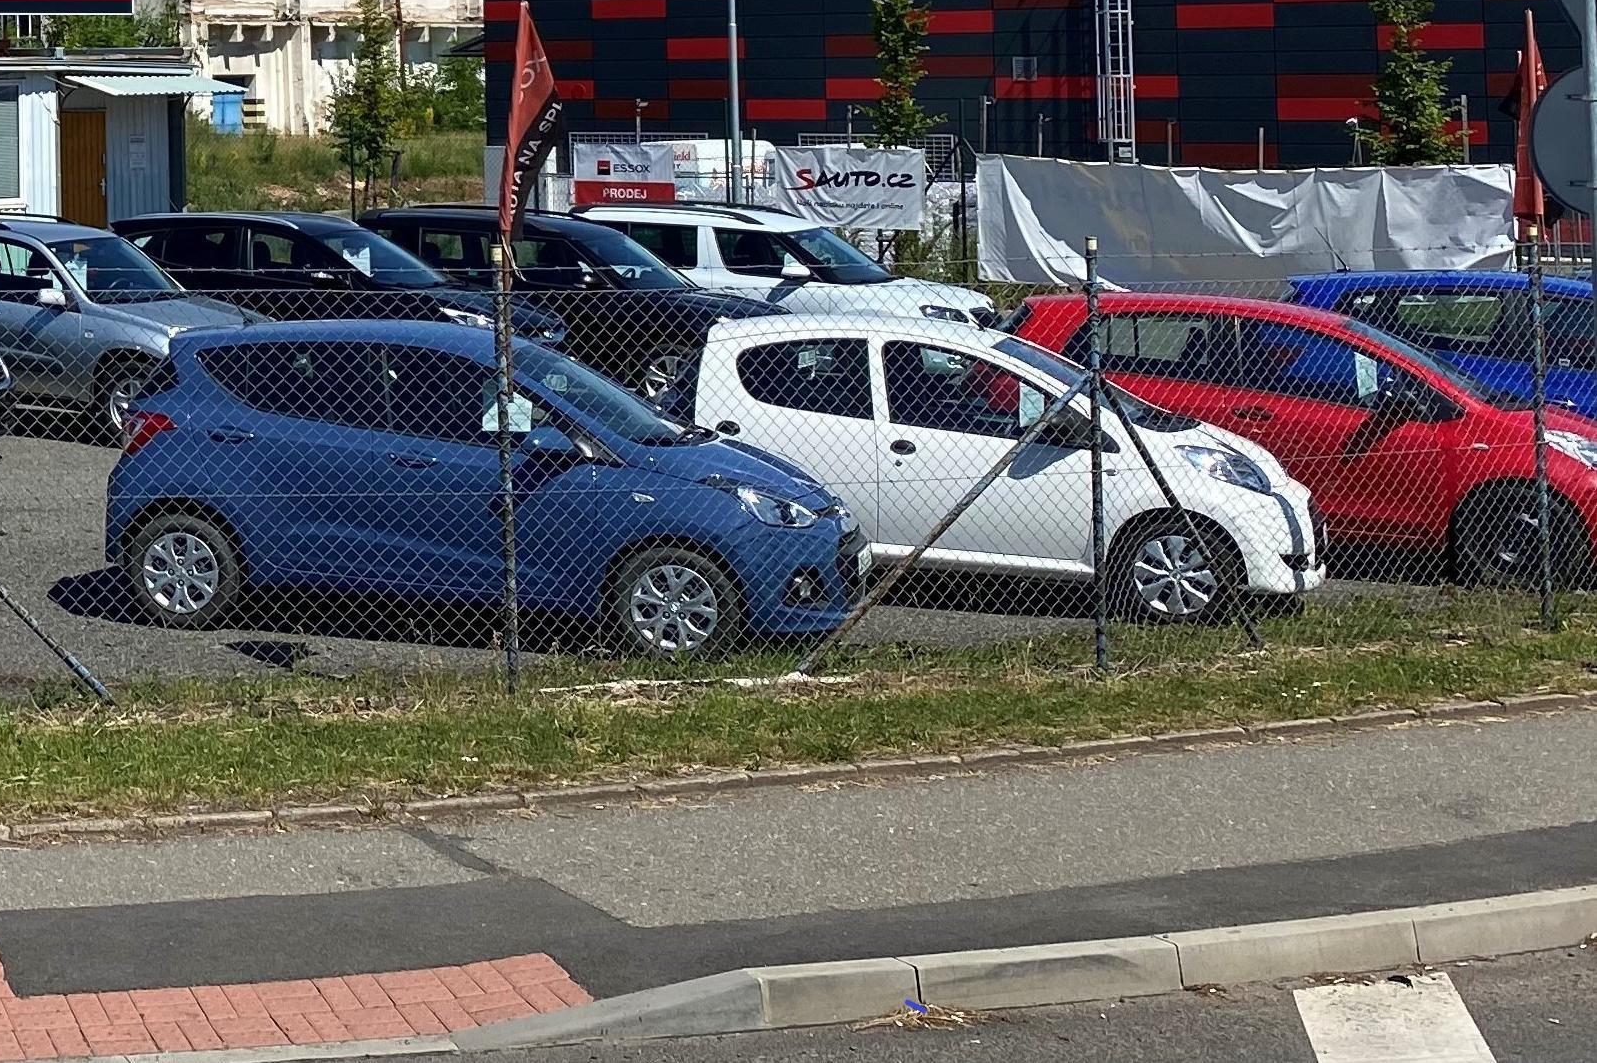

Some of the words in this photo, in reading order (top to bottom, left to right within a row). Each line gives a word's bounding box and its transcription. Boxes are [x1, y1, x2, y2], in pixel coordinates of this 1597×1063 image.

[518, 140, 542, 165] NA
[613, 163, 652, 173] ESSOX
[602, 187, 648, 199] PRODEJ
